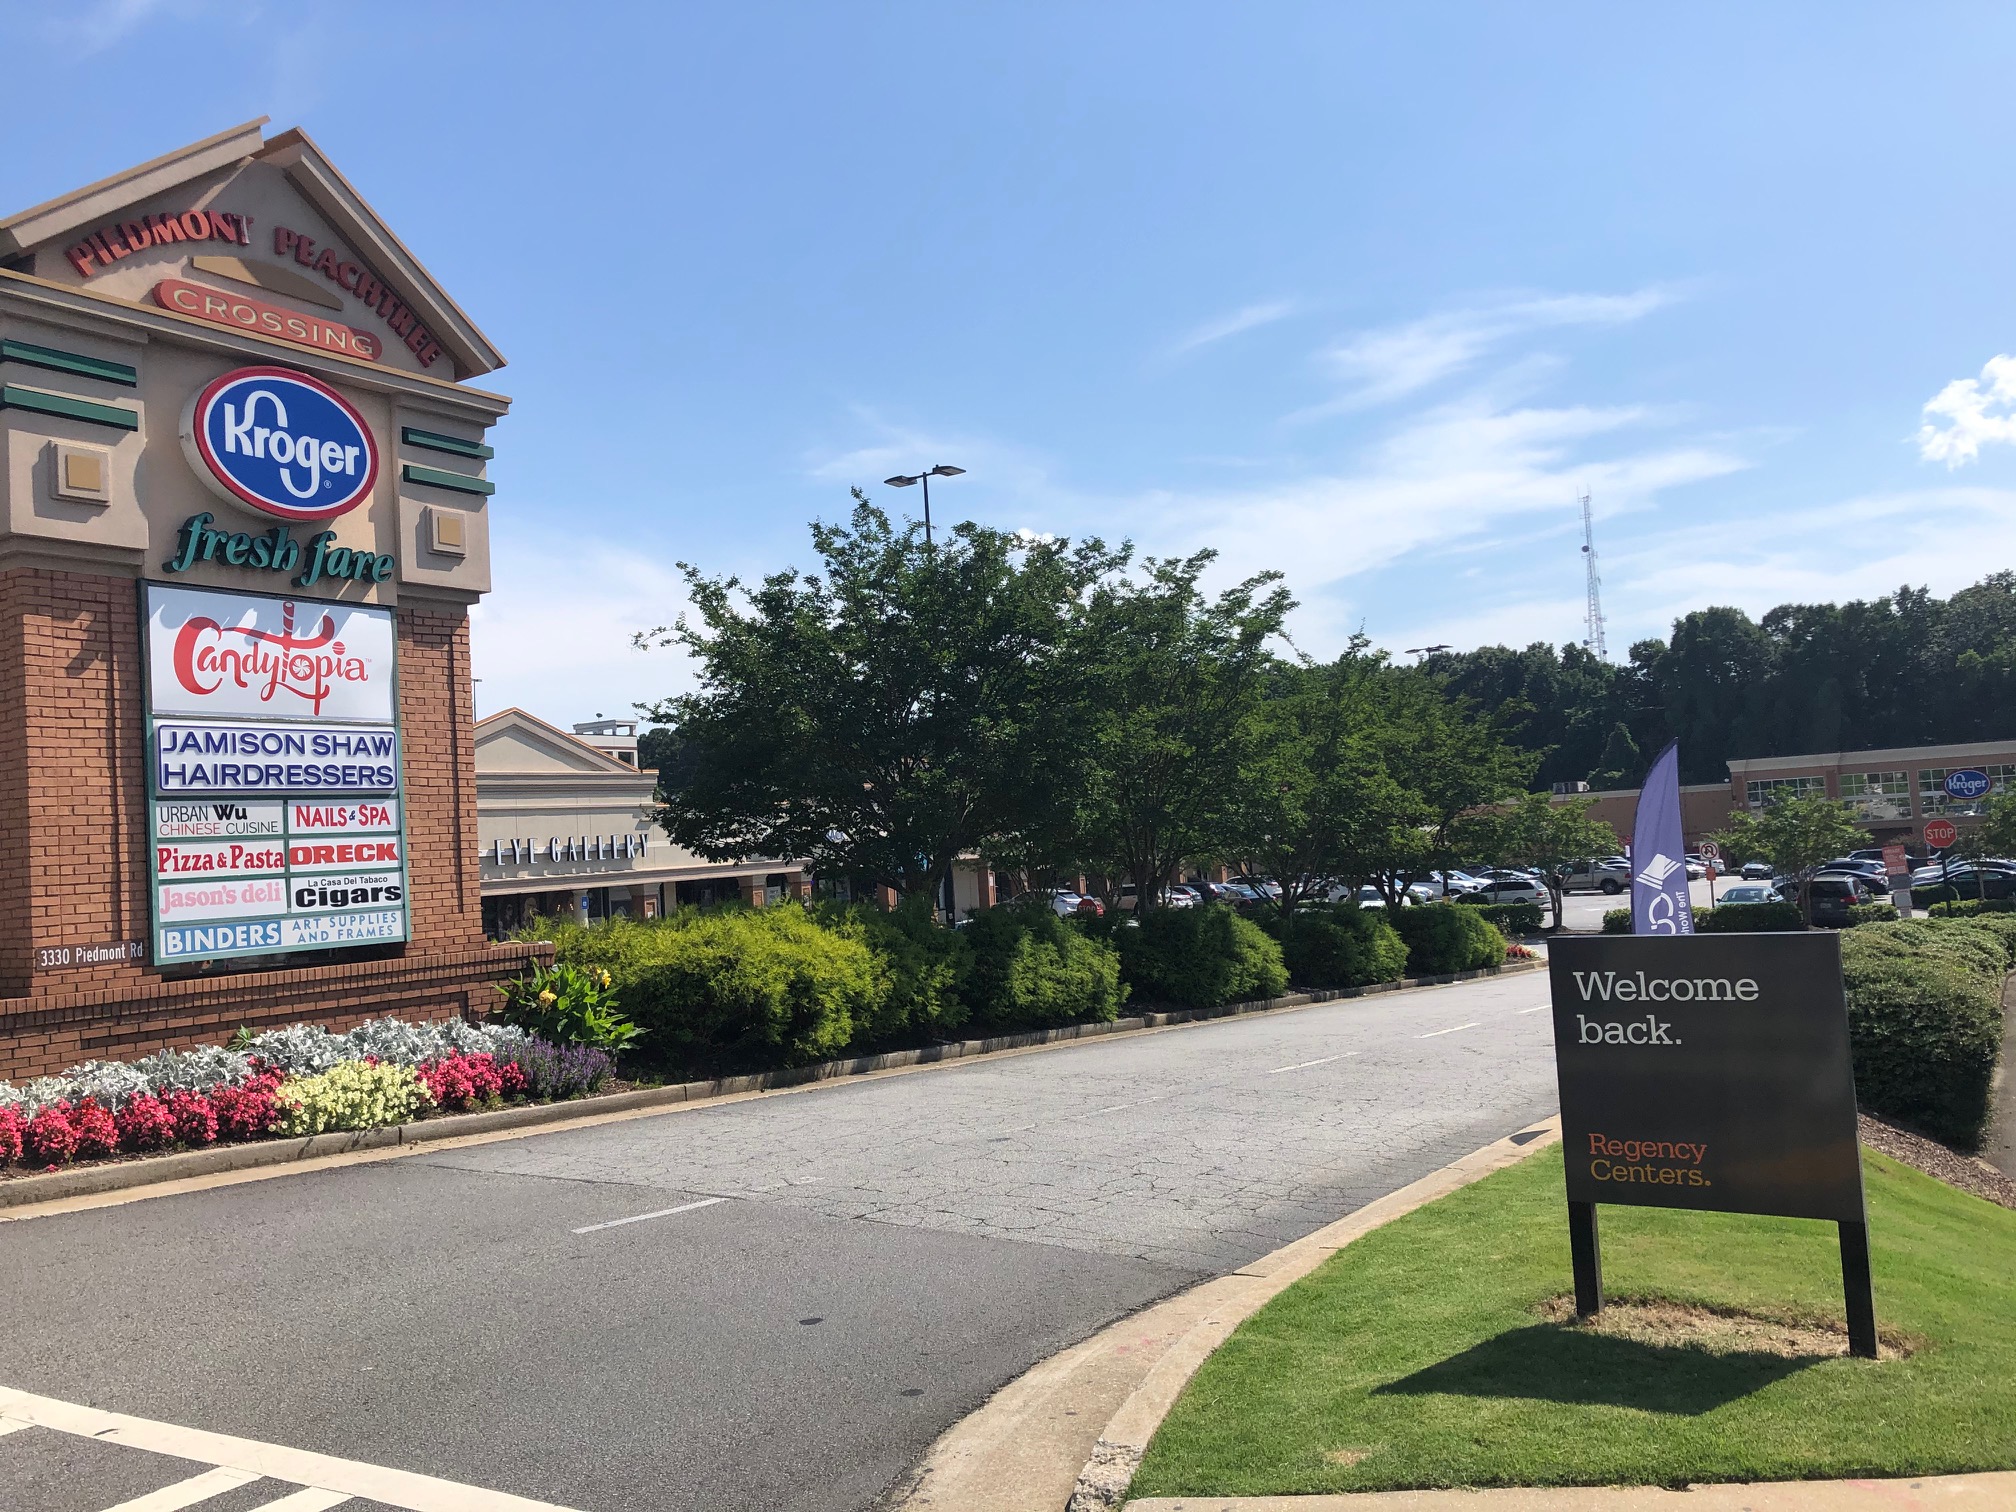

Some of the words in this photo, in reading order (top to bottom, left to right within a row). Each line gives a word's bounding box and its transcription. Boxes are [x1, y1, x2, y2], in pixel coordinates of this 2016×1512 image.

[65, 210, 254, 278] PIEDMONT
[274, 225, 444, 368] PEACHTREE
[173, 288, 375, 356] CROSSING
[223, 390, 360, 499] Kroger
[166, 512, 299, 573] fresh
[296, 531, 396, 587] fare
[162, 731, 305, 755] JAMISON
[312, 734, 393, 757] SHAW
[164, 762, 394, 786] HAIRDRESSERS
[1948, 773, 1987, 795] Kroger
[159, 805, 209, 823] URBAN
[212, 804, 248, 821] Wu
[296, 805, 348, 828] NAILS
[358, 804, 391, 826] SPA
[159, 823, 221, 836] CHINESE
[225, 821, 279, 834] CUISINE
[1926, 828, 1954, 840] STOP
[157, 847, 214, 873] Pizza
[229, 845, 285, 870] Pasta
[289, 843, 399, 866] ORECK
[494, 837, 538, 866] EYE
[549, 833, 649, 863] GALLERY
[308, 879, 319, 888] La
[320, 877, 342, 887] Casa
[344, 877, 357, 886] Del
[359, 876, 388, 885] Tabaco
[160, 885, 237, 915] Jason's
[241, 882, 281, 903] deli
[295, 885, 402, 908] Cigars
[292, 918, 322, 931] ART
[329, 912, 397, 927] SUPPLIES
[297, 930, 329, 943] AND
[337, 925, 394, 940] FRAMES
[166, 923, 280, 954] BINDERS
[40, 948, 70, 967] 3330
[75, 943, 126, 963] Piedmont
[130, 942, 143, 958] Rd
[1573, 971, 1759, 1001] Welcome
[1577, 1015, 1682, 1046] back.
[1588, 1133, 1707, 1164] Regency
[1590, 1159, 1711, 1187] Centers.
